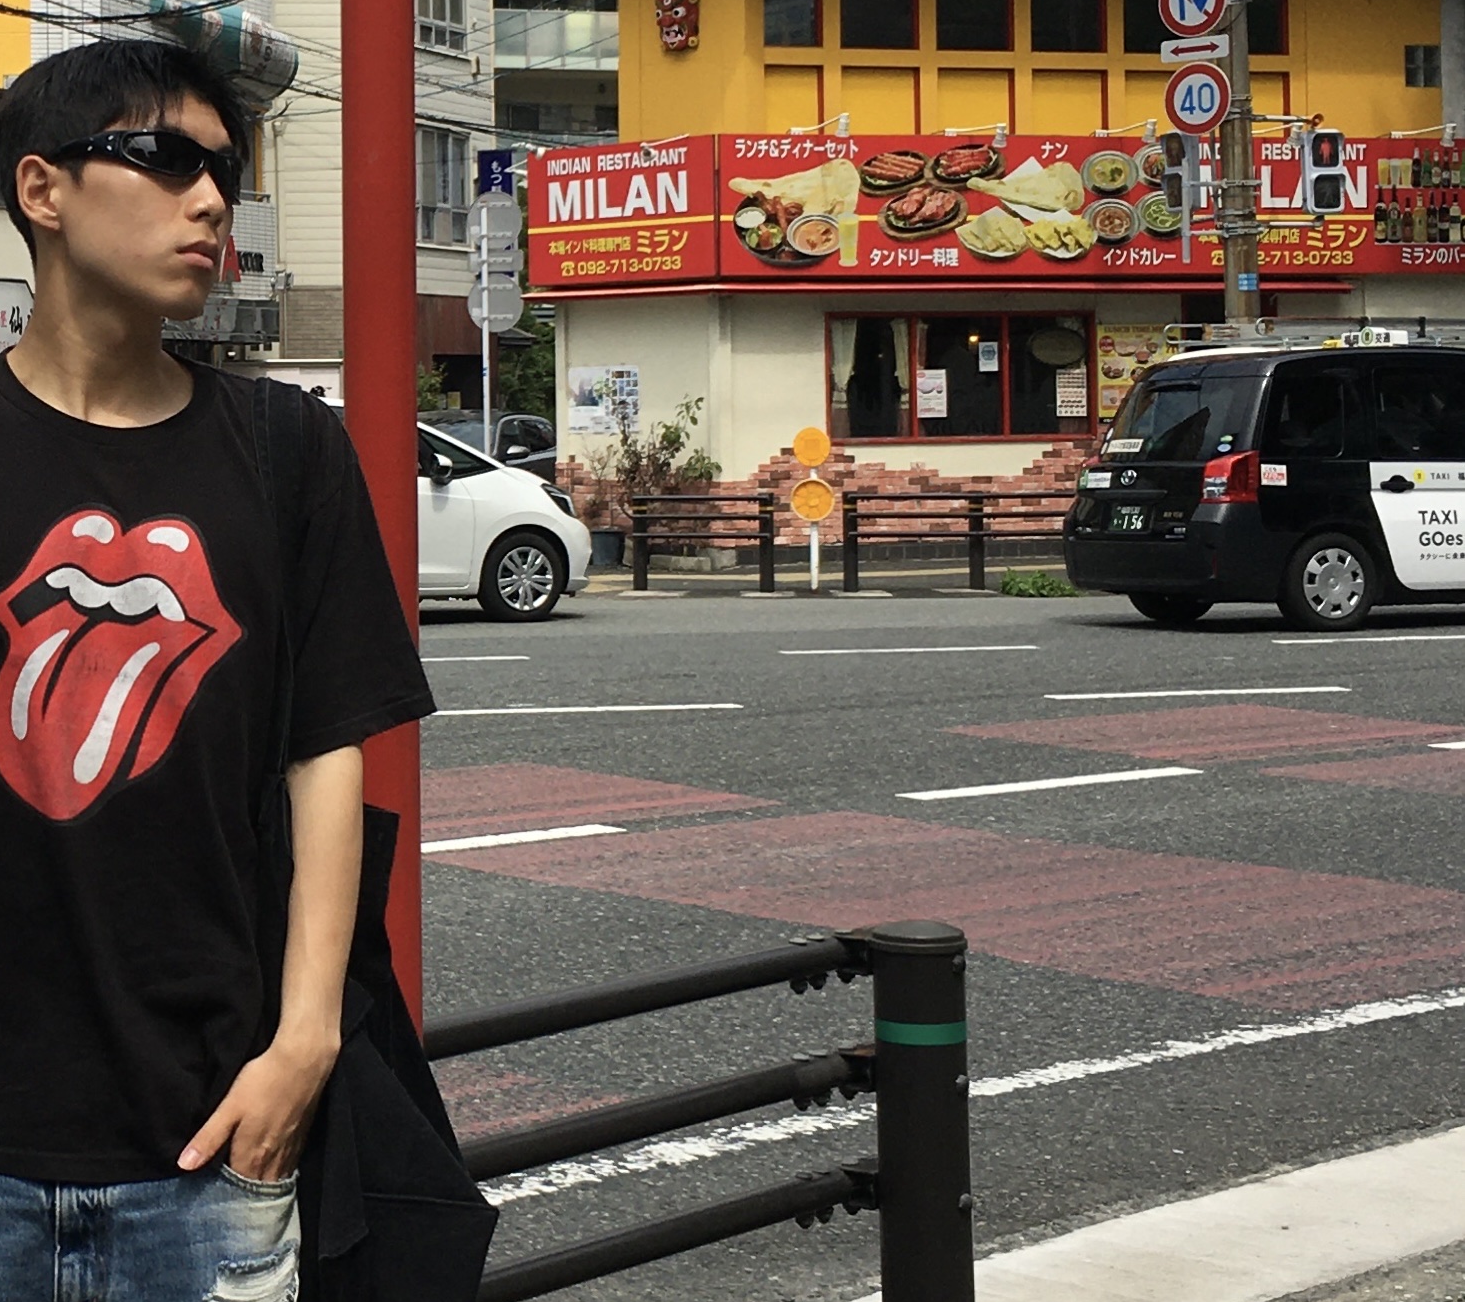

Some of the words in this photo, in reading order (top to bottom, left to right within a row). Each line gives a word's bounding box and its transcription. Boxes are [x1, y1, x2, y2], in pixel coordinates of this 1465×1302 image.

[1180, 82, 1215, 115] 40
[735, 138, 859, 159] ランチ&ディナーセット
[1040, 141, 1069, 159] ナン
[547, 156, 591, 177] INDIAN
[548, 170, 688, 223] MILAN
[548, 237, 632, 256] 本場インド料理専門店
[636, 229, 688, 254] ミラン
[1307, 224, 1368, 248] ミラン
[577, 256, 682, 276] 092-713-0733
[869, 247, 959, 267] タンドリー料理
[1103, 247, 1177, 266] インドカレー
[1430, 472, 1450, 480] TAXI
[1418, 509, 1458, 525] TAXI
[1419, 530, 1464, 547] GOes
